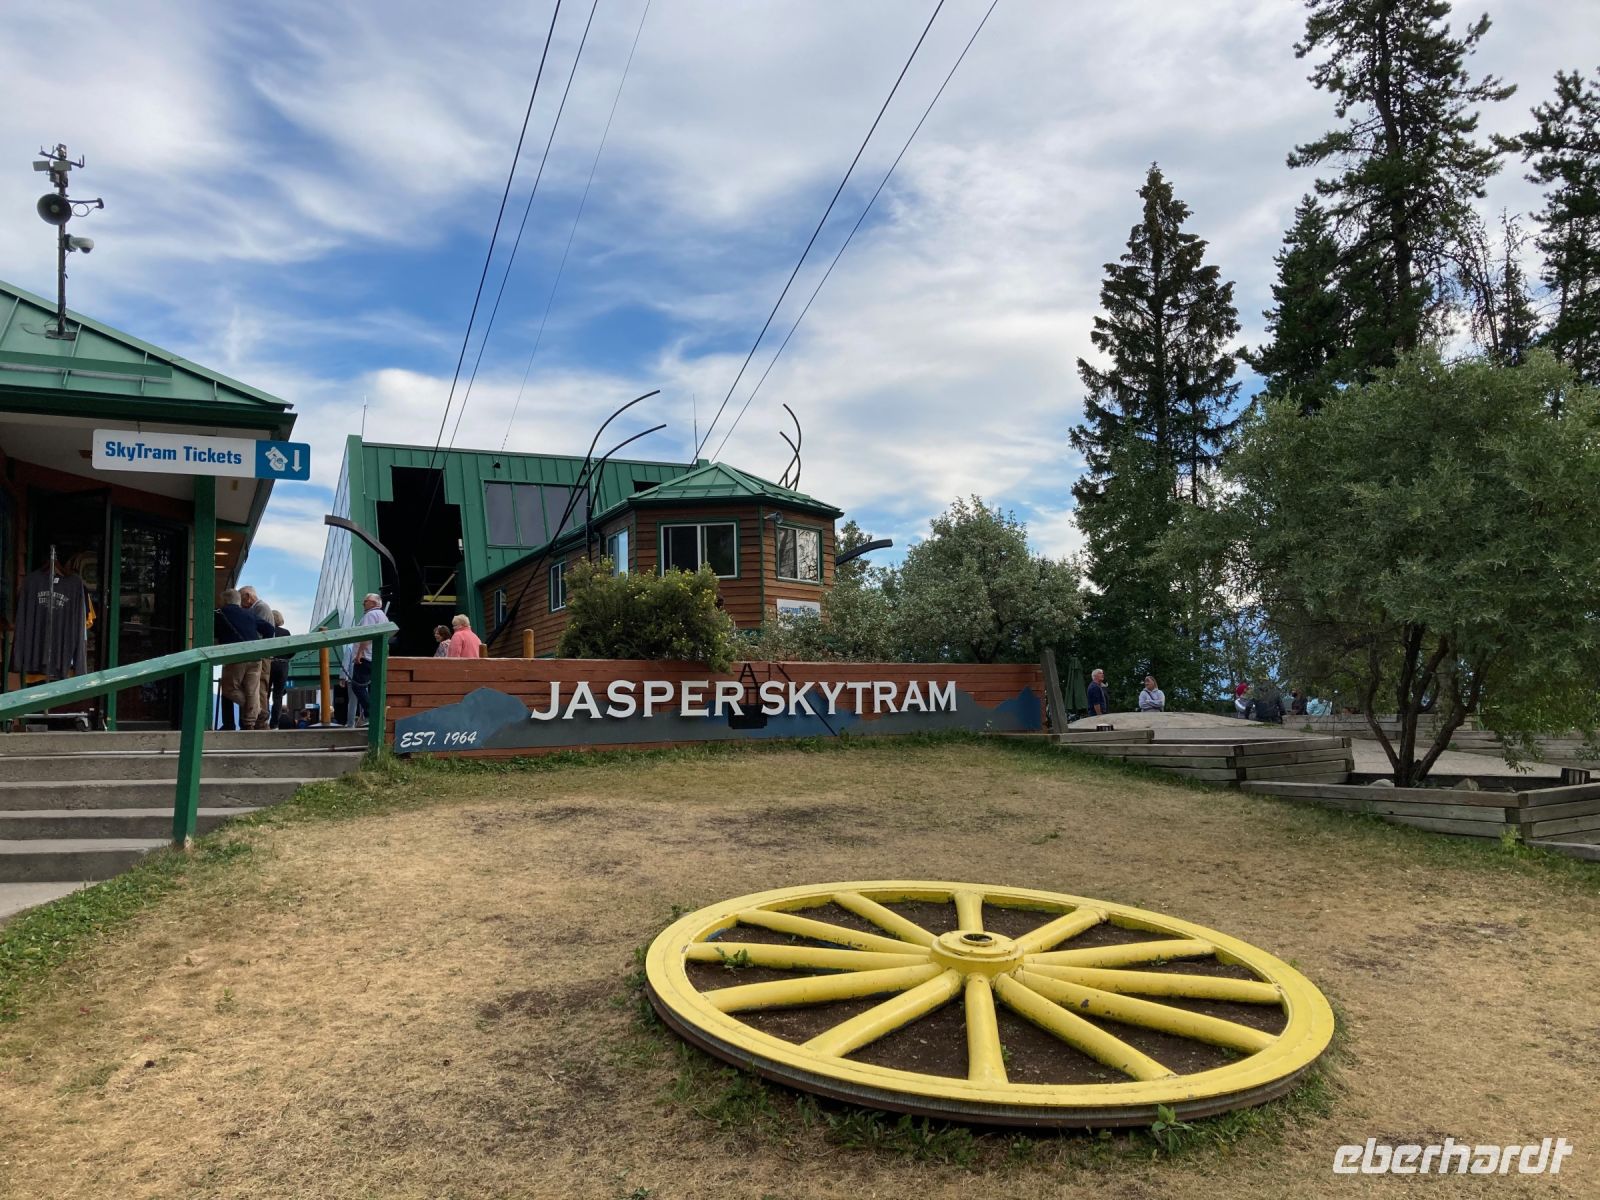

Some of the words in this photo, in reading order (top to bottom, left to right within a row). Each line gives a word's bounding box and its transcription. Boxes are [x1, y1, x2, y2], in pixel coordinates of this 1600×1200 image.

[105, 441, 177, 462] SkyTram
[183, 445, 242, 465] Tickets
[531, 680, 745, 721] JASPER
[759, 680, 957, 716] SKYTRAM
[400, 731, 436, 748] EST.
[443, 731, 478, 745] 1964
